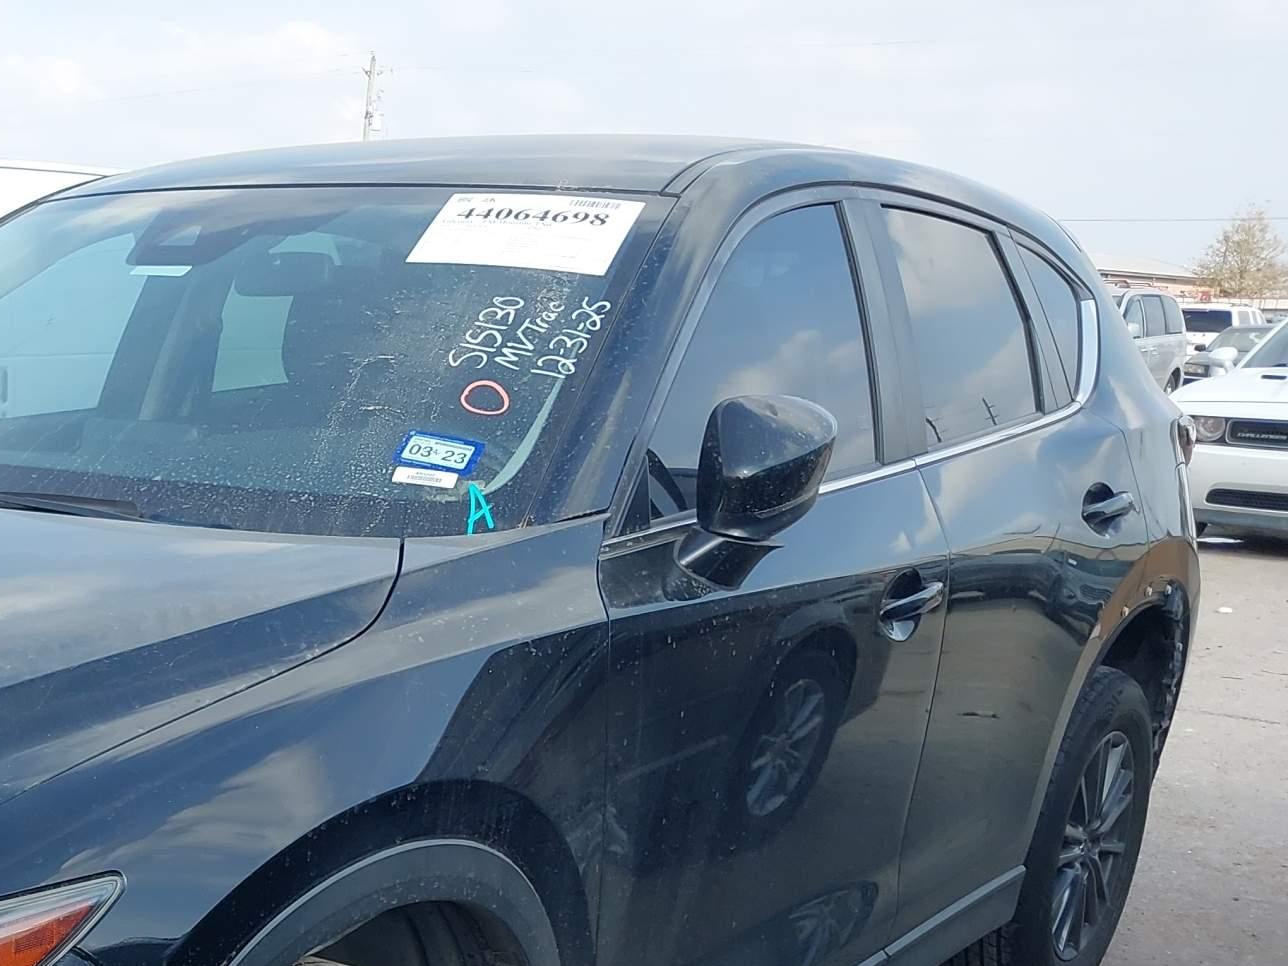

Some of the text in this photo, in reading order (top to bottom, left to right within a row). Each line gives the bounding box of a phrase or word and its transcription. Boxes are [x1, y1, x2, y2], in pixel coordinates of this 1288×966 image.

[457, 207, 609, 226] 44064698
[530, 296, 612, 379] 12-31-25
[466, 480, 495, 536] A
